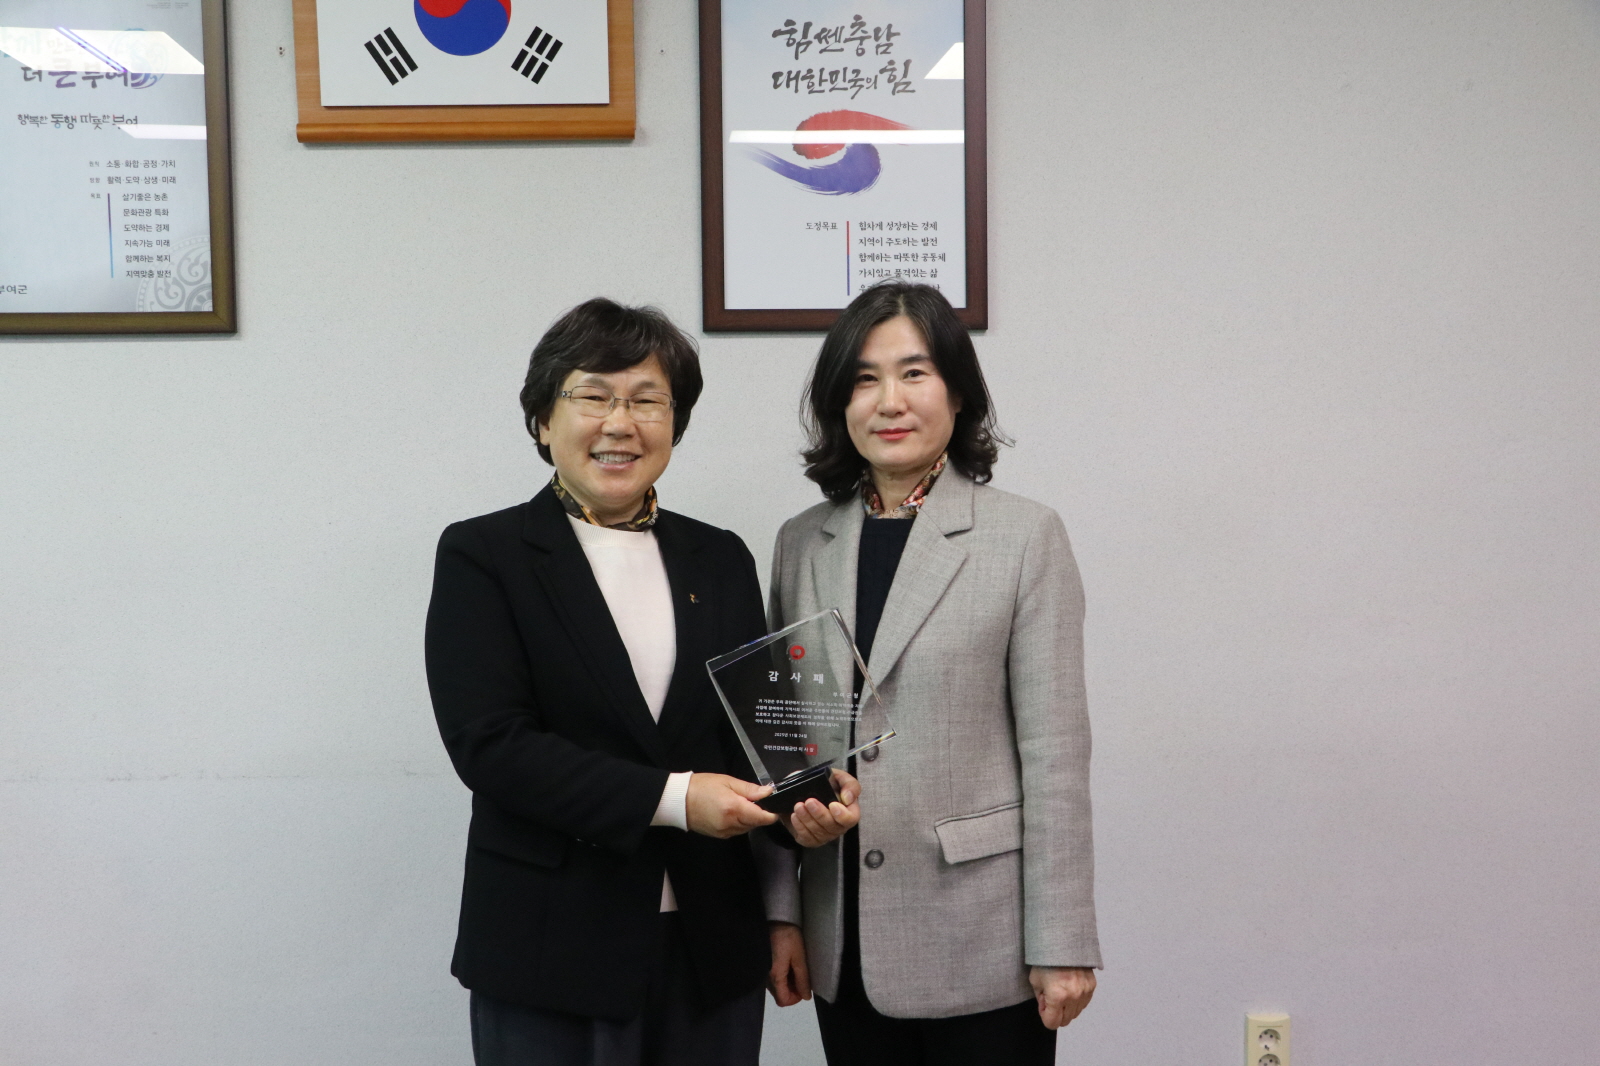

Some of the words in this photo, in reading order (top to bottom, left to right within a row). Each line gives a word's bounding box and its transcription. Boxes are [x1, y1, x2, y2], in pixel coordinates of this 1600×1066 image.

[771, 14, 901, 60] 힘쎈충남
[879, 59, 916, 96] 힘
[17, 113, 49, 129] 행복한
[50, 113, 78, 130] 동행
[79, 112, 111, 130] 따뜻한
[122, 193, 152, 202] 살기좋은
[153, 193, 169, 202] 농촌
[123, 208, 152, 217] 문화관광
[154, 208, 169, 217] 특화
[123, 223, 153, 232] 도약하는
[155, 223, 170, 232] 경제
[805, 221, 838, 231] 도정목표
[858, 221, 883, 231] 힘차게
[885, 221, 919, 231] 성장하는
[921, 221, 938, 231] 경제
[124, 239, 153, 248] 지속가능
[155, 239, 171, 248] 미래
[858, 237, 883, 247] 지역이
[885, 237, 919, 247] 주도하는
[921, 237, 938, 247] 발전
[125, 254, 154, 263] 함께하는
[156, 254, 171, 263] 복지
[858, 252, 892, 263] 함께하는
[893, 252, 919, 263] 따뜻한
[921, 252, 946, 263] 공동체
[125, 270, 155, 279] 지역맞춤
[156, 270, 172, 279] 발전
[858, 268, 892, 279] 가치있고
[929, 268, 938, 279] 삶
